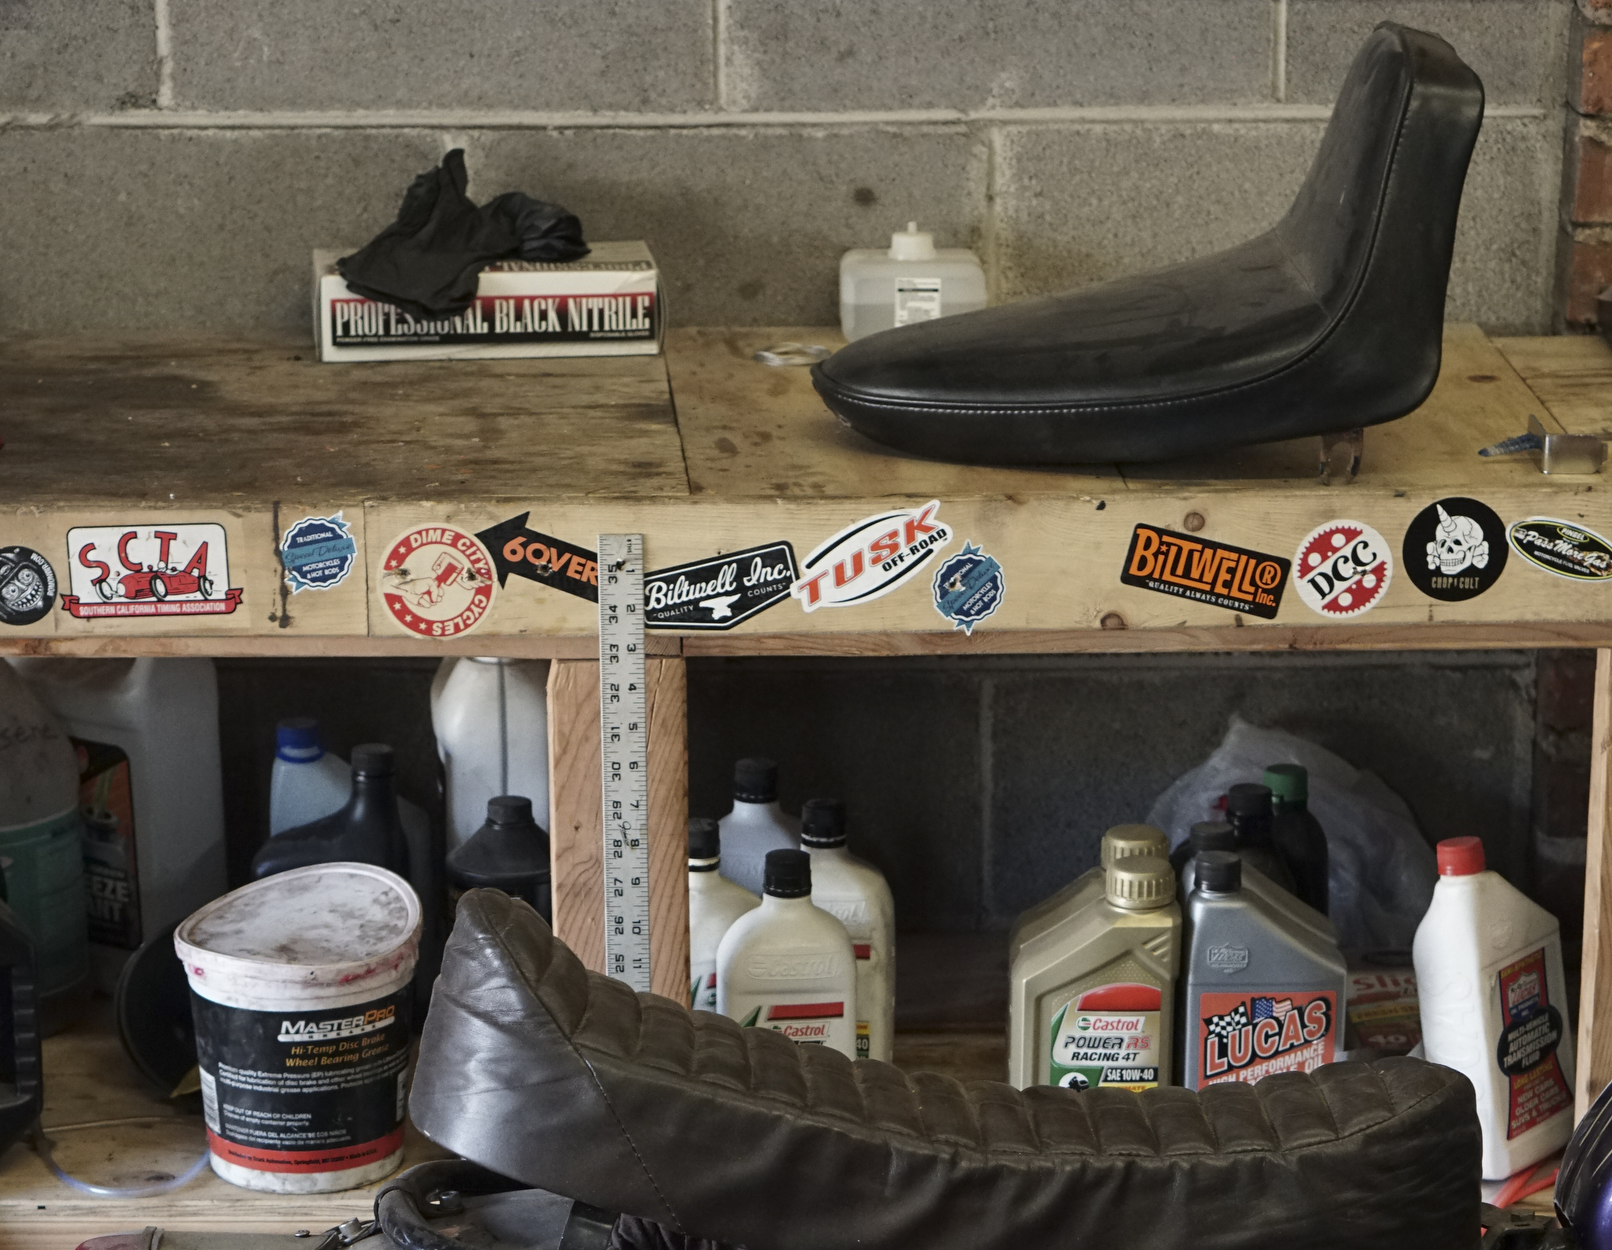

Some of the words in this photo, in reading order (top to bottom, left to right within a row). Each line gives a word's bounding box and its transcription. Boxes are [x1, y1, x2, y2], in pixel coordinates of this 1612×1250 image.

[494, 297, 562, 334] BLACK
[567, 295, 650, 332] NITRILE
[409, 529, 455, 549] DIME
[457, 537, 488, 572] CITY
[799, 504, 939, 607] TUSK
[882, 527, 948, 572] OFF-ROAD
[1524, 530, 1554, 550] Pass
[1554, 540, 1586, 561] More
[1584, 551, 1608, 569] Gas
[608, 564, 618, 584] 35
[1307, 540, 1377, 600] DCC
[645, 562, 737, 610] Biltwell
[743, 556, 792, 587] Inc.
[1459, 577, 1480, 589] CULT
[1185, 587, 1216, 604] ALWAYS
[1255, 590, 1277, 607] Inc.
[79, 604, 116, 616] SOUTHERN
[116, 603, 156, 614] CALIFORNIA
[157, 604, 181, 613] TIMING
[181, 602, 226, 613] ASSOCIATION
[432, 594, 488, 636] CYCLES
[609, 605, 618, 624] 34
[627, 604, 636, 613] 2
[610, 643, 619, 663] 33
[627, 643, 636, 652] 3
[610, 683, 620, 703] 32
[628, 683, 637, 691] 4
[611, 725, 621, 742] 31
[629, 722, 638, 731] 5
[612, 761, 621, 781] 30
[629, 761, 638, 770] 6
[612, 801, 622, 819] 29
[630, 801, 639, 809] 7
[613, 839, 623, 858] 28
[631, 838, 640, 847] 8
[614, 878, 623, 897] 27
[631, 877, 641, 886] 9
[615, 916, 624, 935] 26
[632, 920, 641, 935] 10
[615, 954, 625, 973] 25
[633, 958, 642, 969] 11
[784, 1024, 826, 1037] Castrol
[1092, 1017, 1140, 1032] Castrol
[291, 1043, 337, 1056] Hi-Temp
[339, 1040, 360, 1052] Disc
[361, 1033, 386, 1046] Brake
[1064, 1036, 1125, 1049] POWER
[1126, 1036, 1151, 1050] RS
[1206, 1000, 1328, 1077] LUCAS
[1509, 1022, 1551, 1055] AUTOMATIC
[285, 1056, 329, 1067] Wheel
[330, 1051, 360, 1066] Bearing
[361, 1043, 390, 1059] Grease
[1071, 1051, 1120, 1062] RACING
[1121, 1051, 1140, 1062] 4T
[1503, 1029, 1558, 1069] TRANSMISSION
[1238, 1041, 1326, 1081] PERFORMANCE
[1304, 1055, 1324, 1074] OIL
[1107, 1068, 1122, 1081] SAE
[1122, 1068, 1154, 1081] 10W-40
[234, 1106, 245, 1114] OUT
[253, 1110, 272, 1119] REACH
[249, 1129, 267, 1137] FUERA
